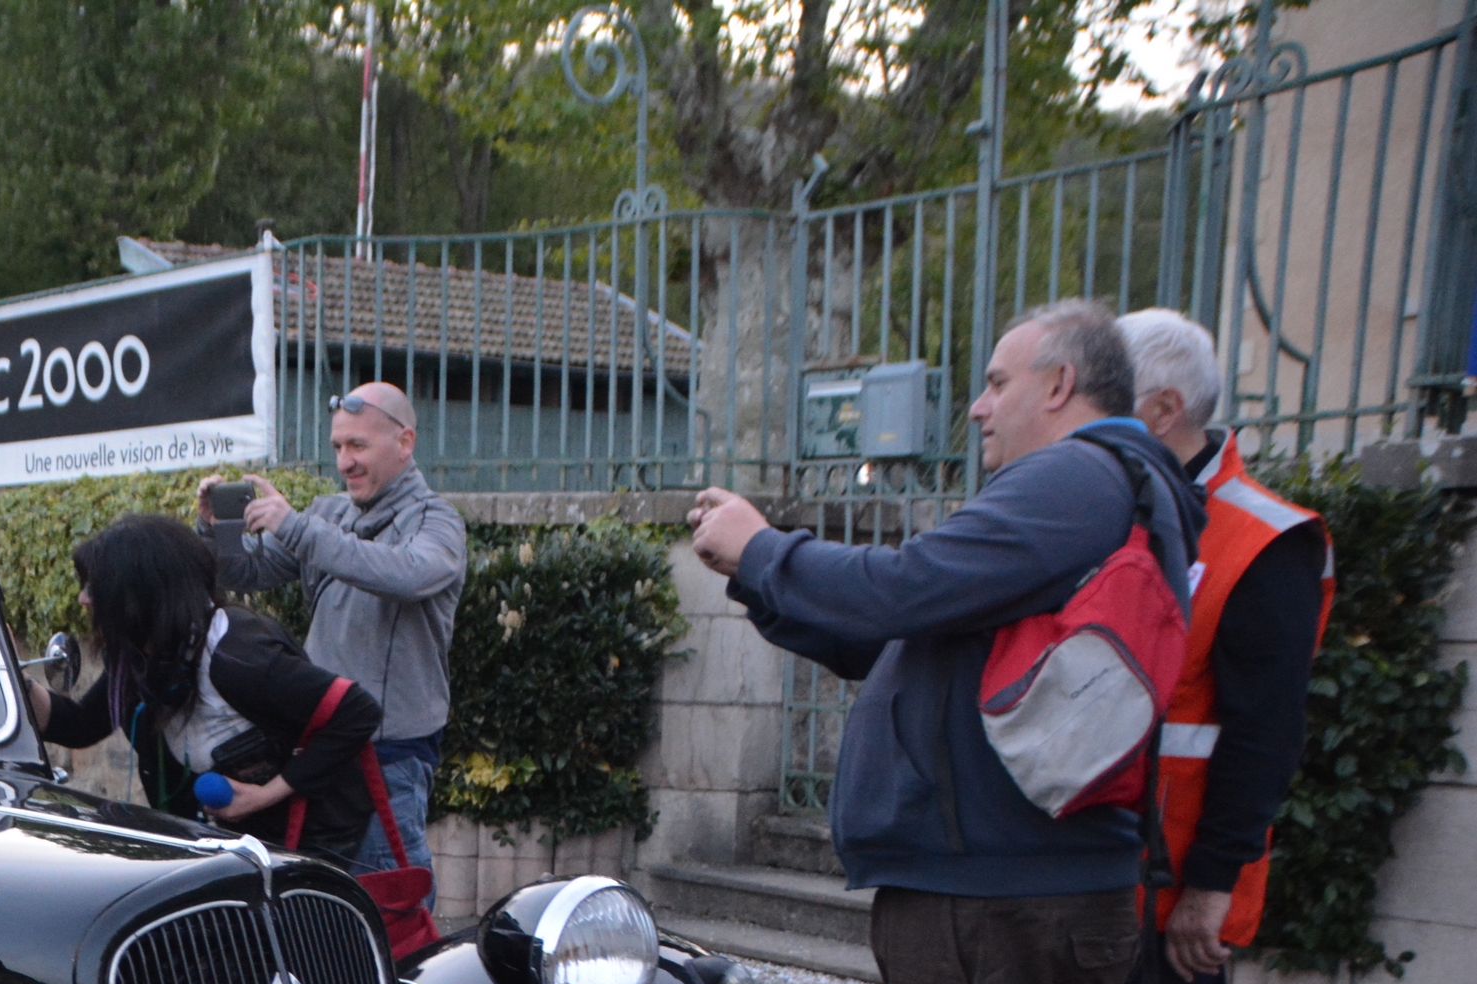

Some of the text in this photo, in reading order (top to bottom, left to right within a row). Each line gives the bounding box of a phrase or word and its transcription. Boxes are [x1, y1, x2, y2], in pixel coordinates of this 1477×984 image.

[18, 334, 150, 411] 2000
[24, 433, 235, 475] Une nouvelle vision de la vie
